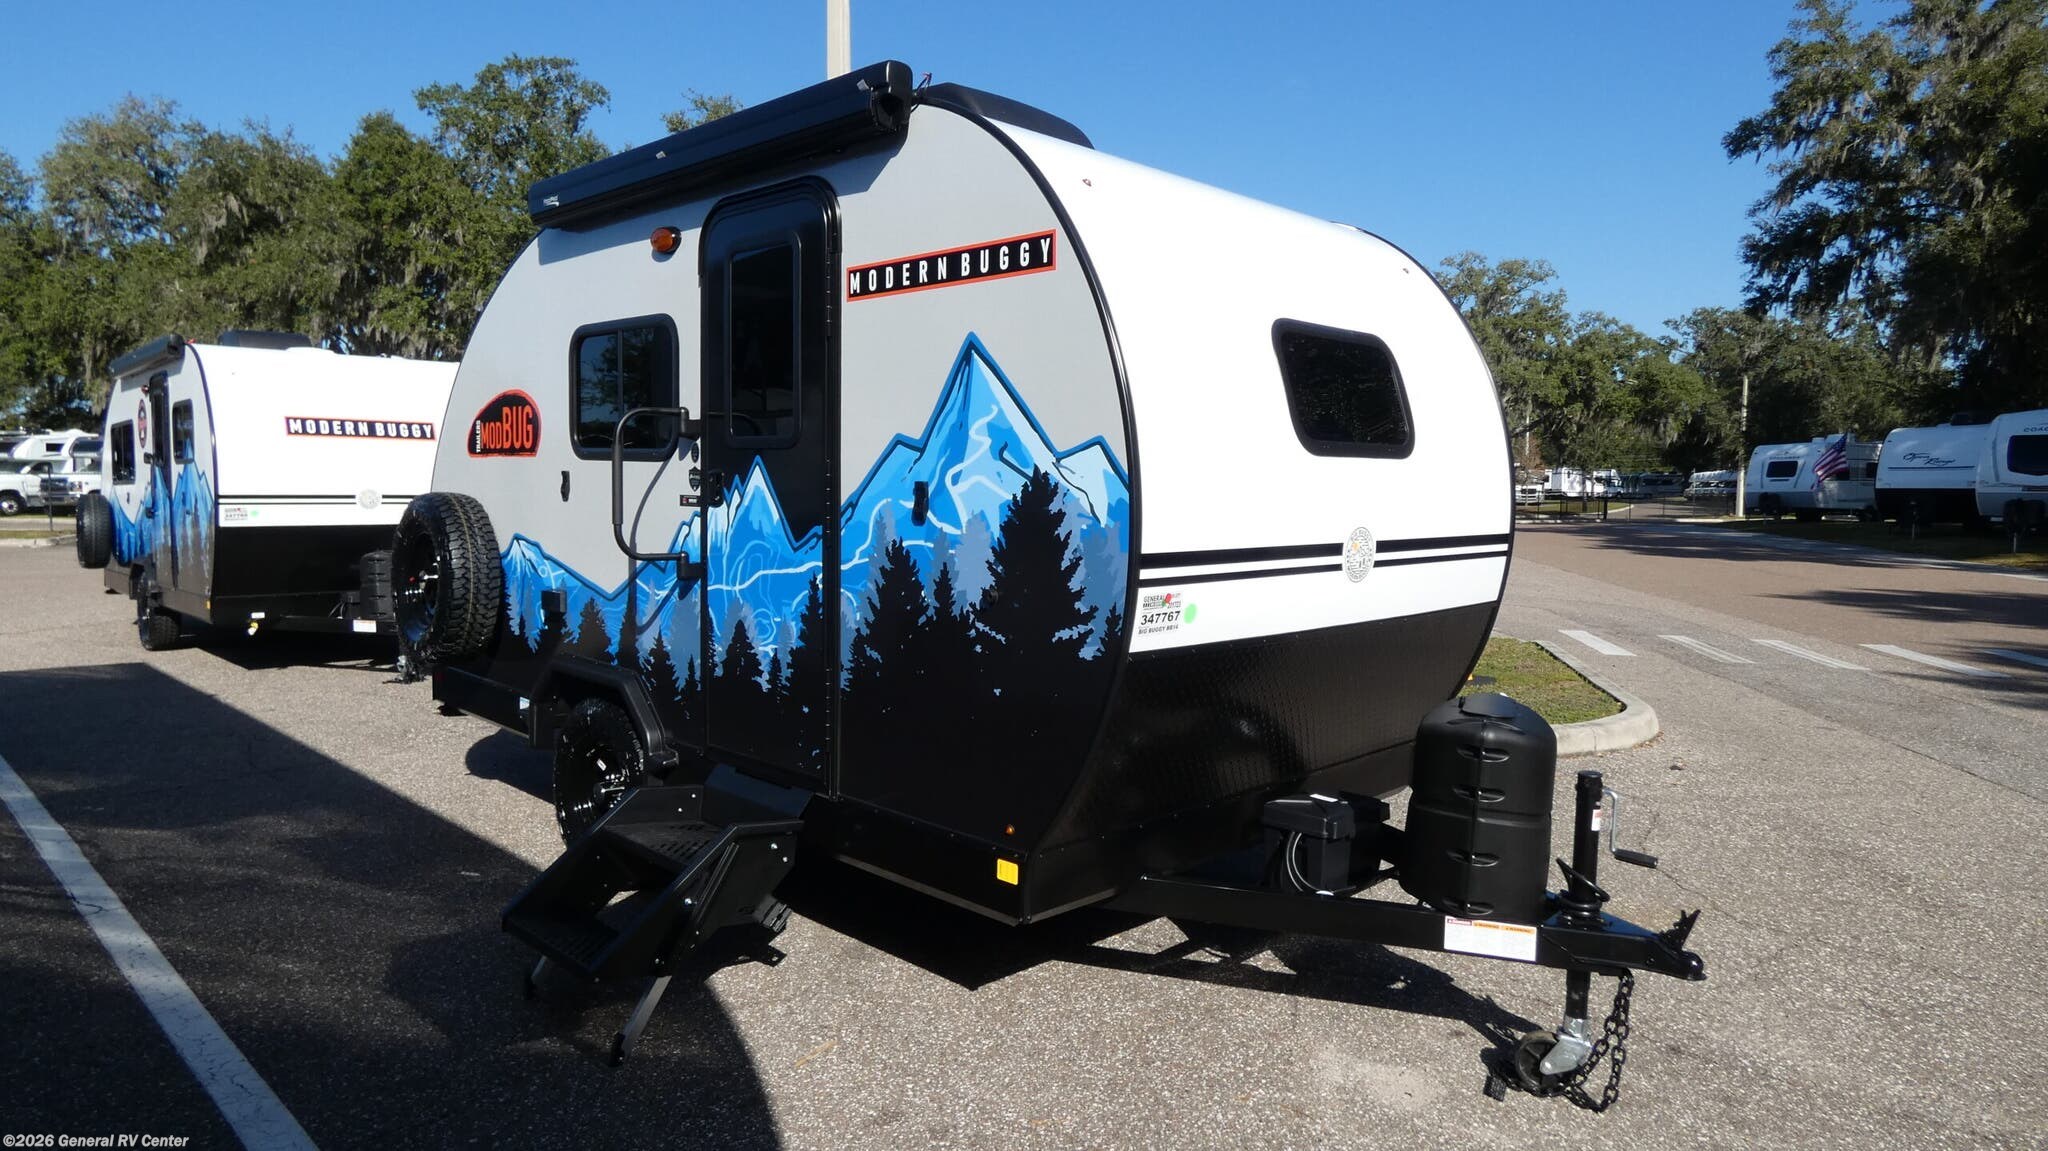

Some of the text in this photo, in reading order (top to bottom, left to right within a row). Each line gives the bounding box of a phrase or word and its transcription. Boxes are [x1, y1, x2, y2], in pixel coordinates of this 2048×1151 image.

[850, 237, 1051, 295] MODERN BUGGY
[288, 418, 432, 439] MODERN BUGGY
[1141, 611, 1180, 625] 347767
